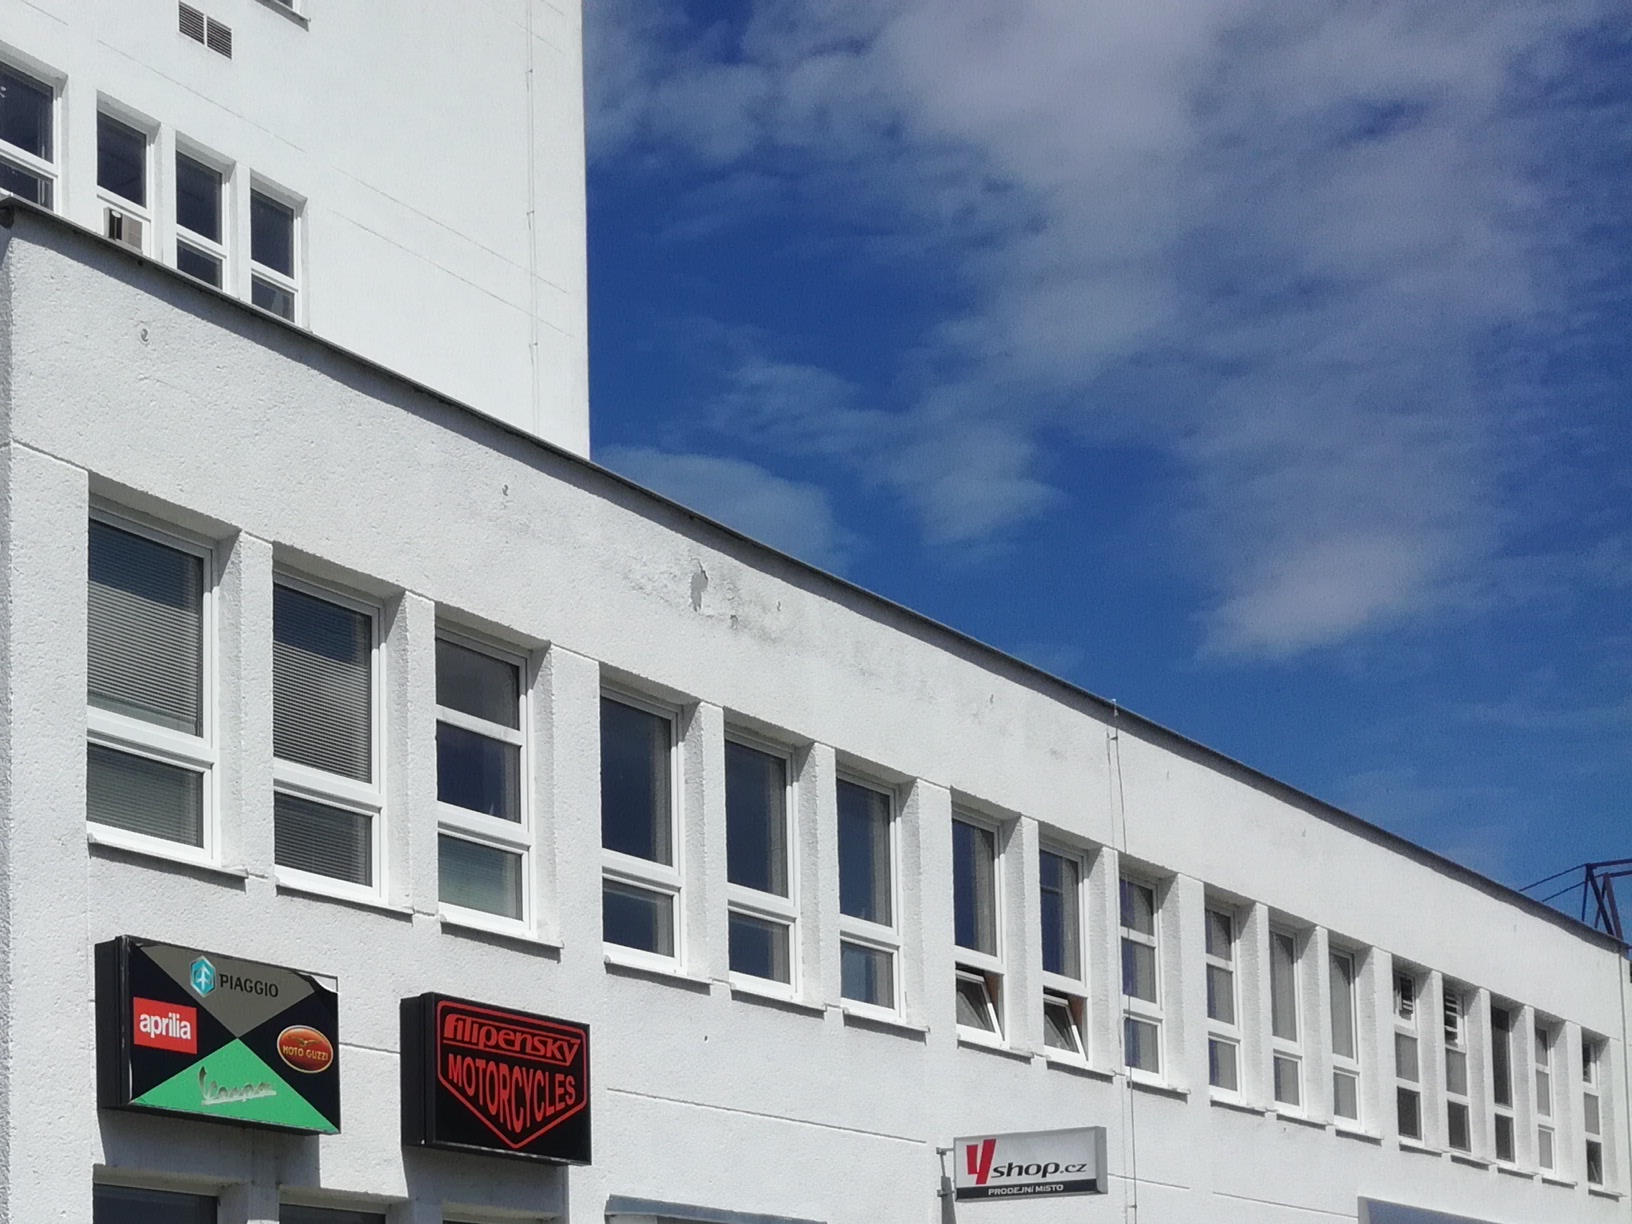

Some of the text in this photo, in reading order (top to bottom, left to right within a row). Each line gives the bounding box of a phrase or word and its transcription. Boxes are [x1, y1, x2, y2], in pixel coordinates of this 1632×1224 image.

[219, 973, 279, 998] PIAGGIO
[139, 1012, 192, 1040] aprilia
[282, 1045, 329, 1061] MOTO GUZZI
[448, 1053, 576, 1133] MOTORCYCLES
